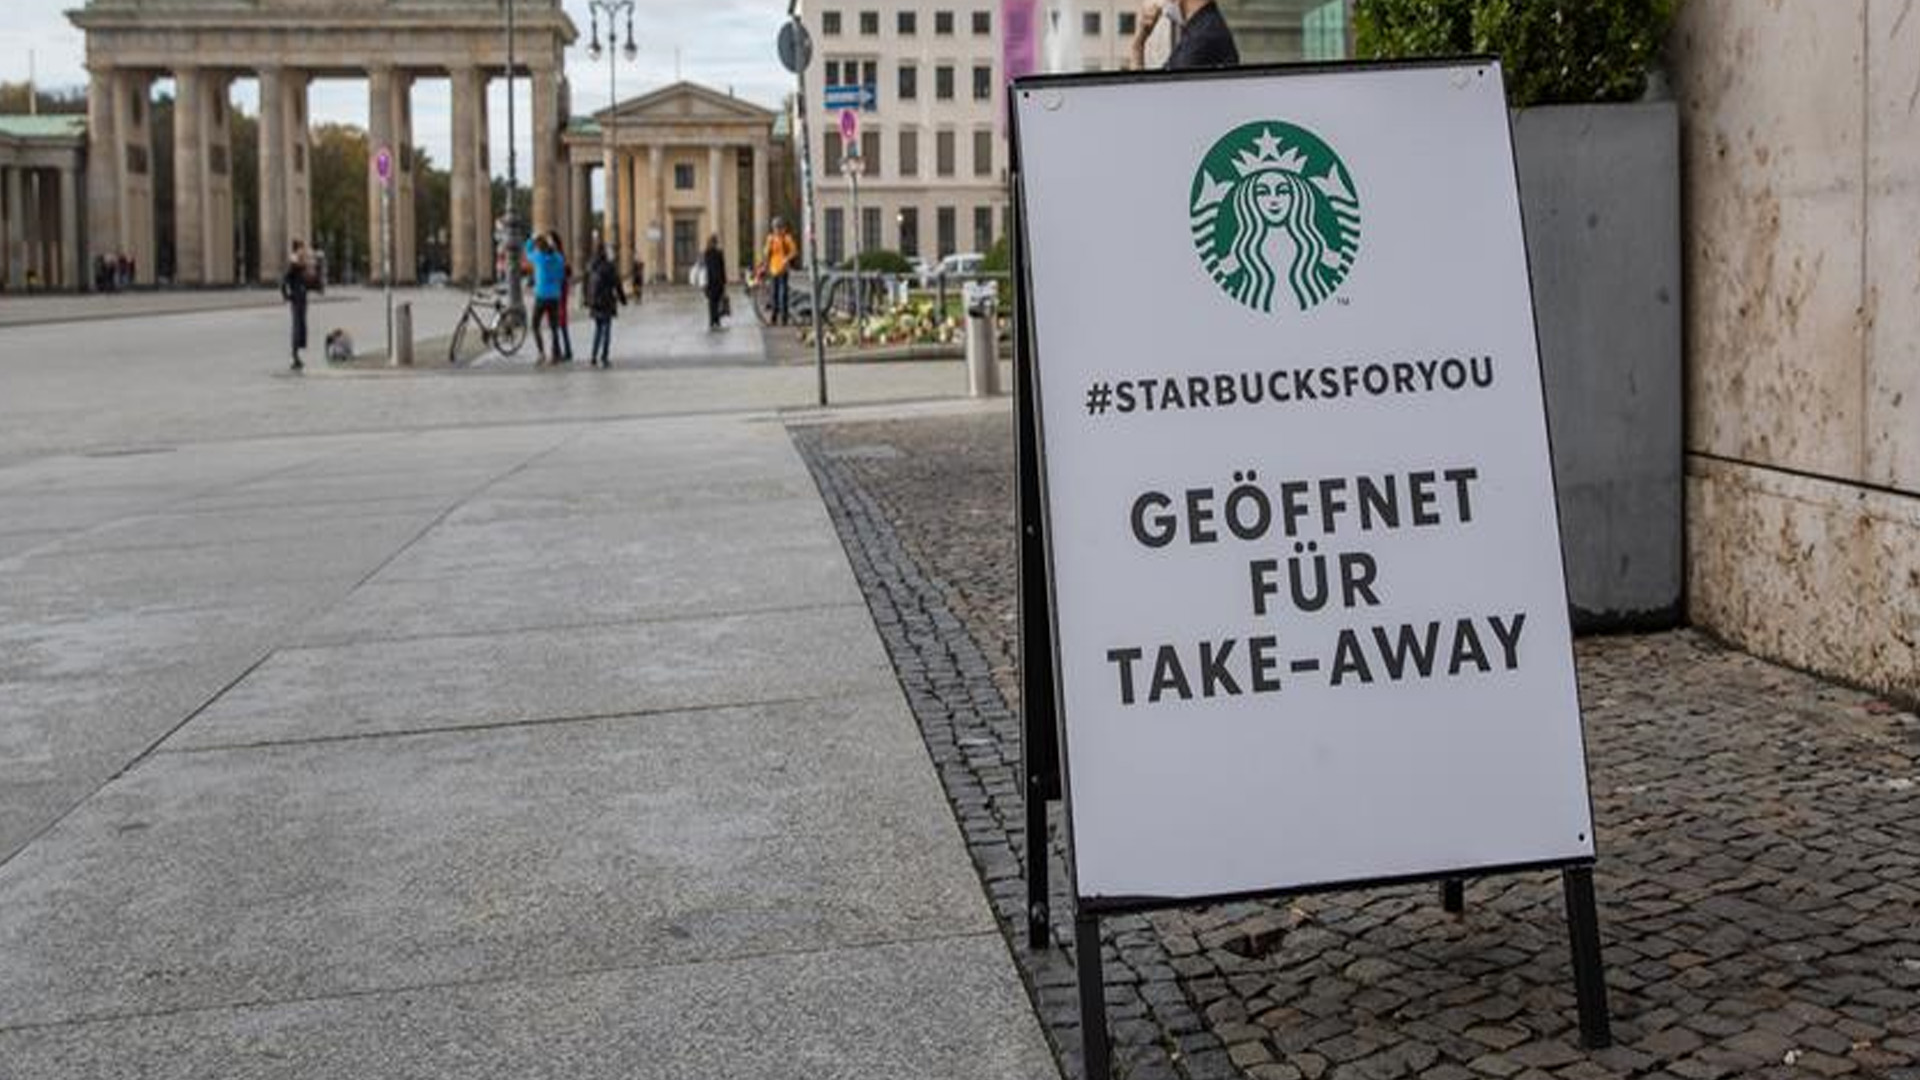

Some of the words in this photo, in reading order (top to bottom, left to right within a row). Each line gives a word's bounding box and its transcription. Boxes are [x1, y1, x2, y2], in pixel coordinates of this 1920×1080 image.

[1085, 356, 1495, 416] #STARBUCKSFORYOU
[1130, 467, 1479, 549] GEÖFFNET
[1249, 541, 1381, 617] FÜR
[1106, 613, 1527, 706] TAKE-AWAY
